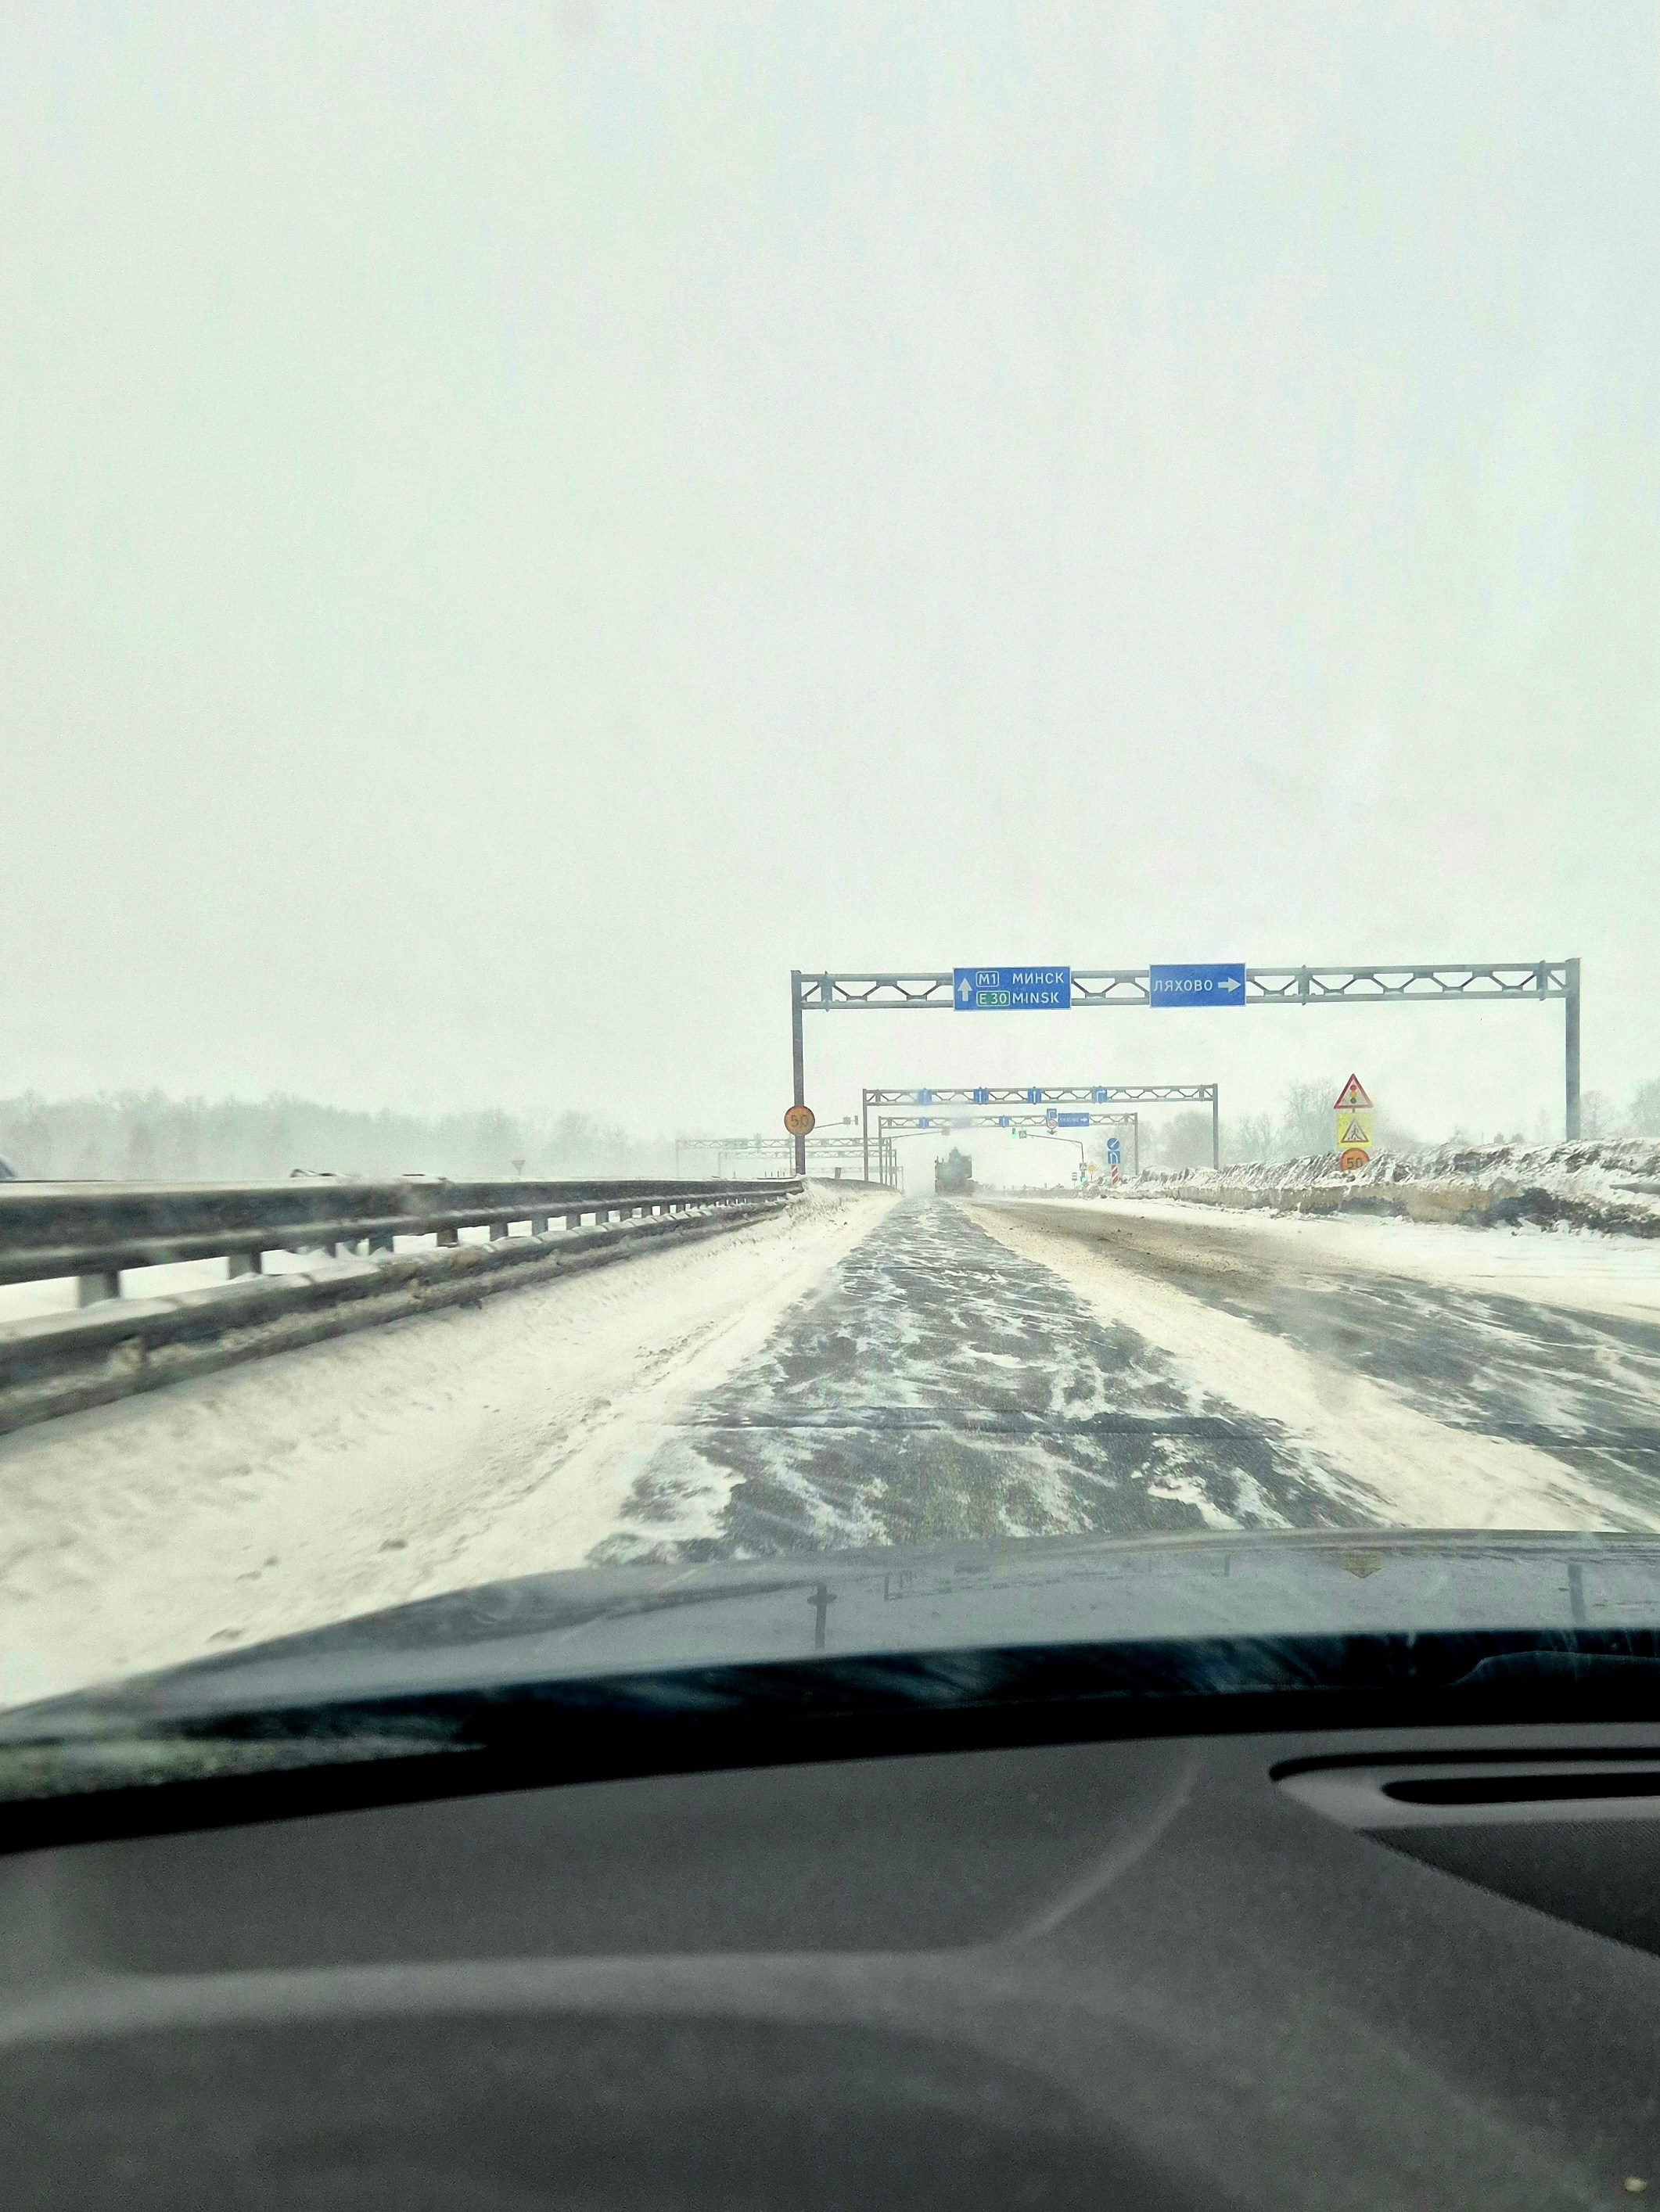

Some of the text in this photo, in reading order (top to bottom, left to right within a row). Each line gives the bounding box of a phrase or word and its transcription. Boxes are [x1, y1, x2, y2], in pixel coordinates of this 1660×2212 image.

[1012, 972, 1065, 985] МИНСК
[1153, 979, 1213, 992] ЛЯХОВО
[1012, 992, 1060, 1004] MINSK
[791, 1114, 810, 1127] 50
[1346, 1158, 1364, 1169] 50
